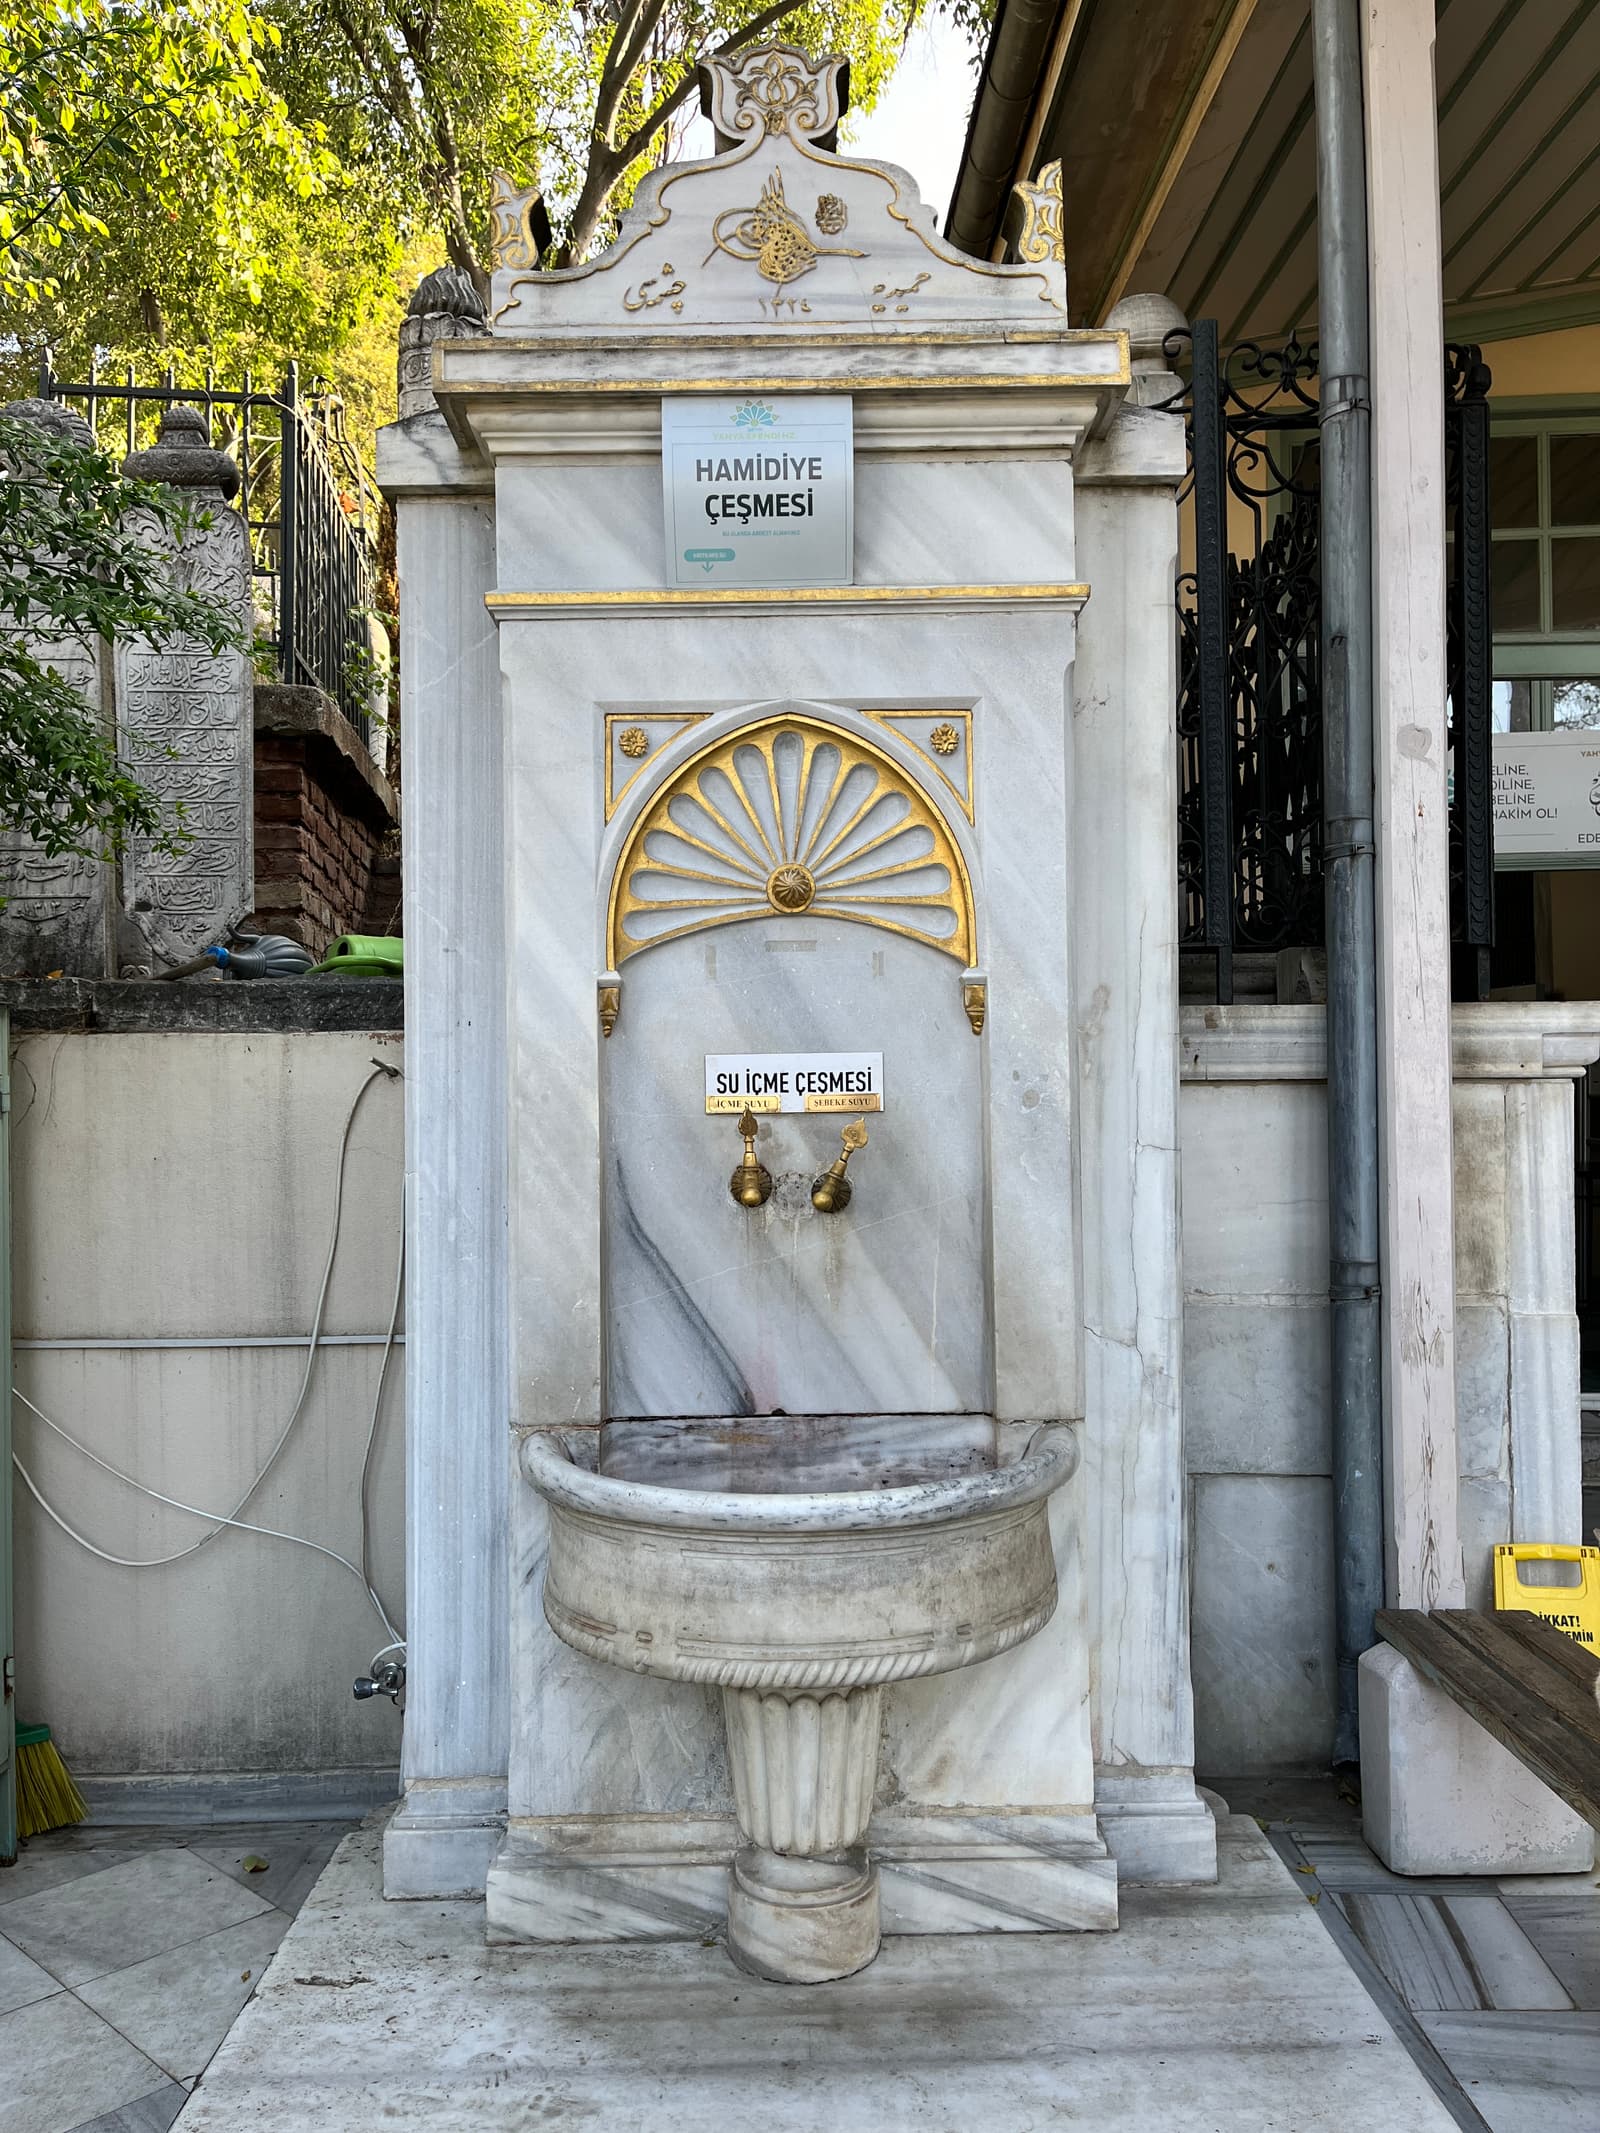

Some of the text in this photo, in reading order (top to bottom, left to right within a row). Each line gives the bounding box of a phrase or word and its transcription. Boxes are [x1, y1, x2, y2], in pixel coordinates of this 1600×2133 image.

[696, 452, 822, 482] HAMİDİYE
[705, 488, 813, 525] ÇEŞMESİ
[1536, 807, 1558, 819] OL!
[716, 1066, 872, 1096] SU İÇME ÇEŞMESİ
[716, 1098, 770, 1109] İÇME SUYU
[814, 1097, 871, 1108] ŞEBEKE SUYU
